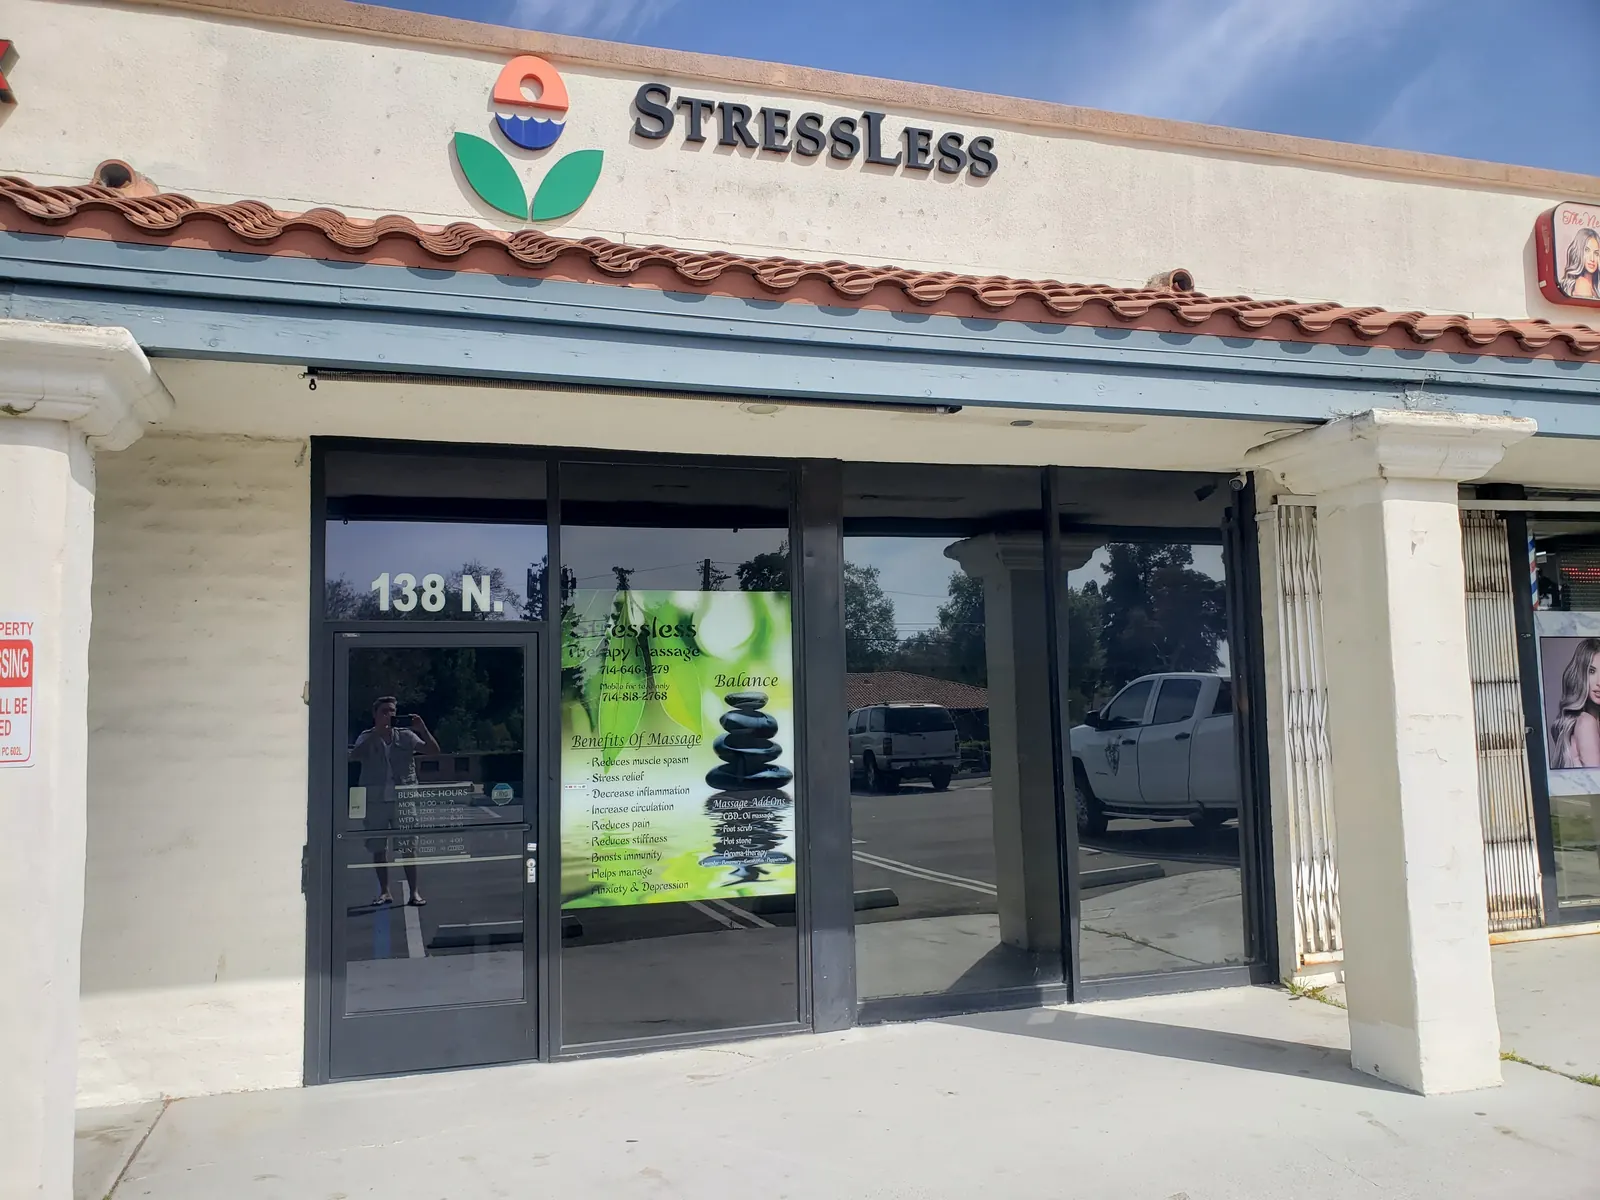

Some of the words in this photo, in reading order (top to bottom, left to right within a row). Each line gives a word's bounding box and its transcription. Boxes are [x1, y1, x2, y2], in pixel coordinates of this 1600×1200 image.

[1562, 210, 1584, 226] The
[371, 572, 446, 612] 138
[462, 574, 503, 612] N.
[0, 648, 29, 679] SING
[714, 672, 779, 688] Balance
[602, 691, 668, 702] 714-818-2768
[14, 697, 28, 714] BE
[571, 733, 625, 751] Benefits
[628, 733, 644, 750] Of
[647, 732, 702, 749] Massage
[1, 746, 10, 756] PC
[592, 757, 630, 768] Reduces
[632, 755, 661, 766] muscle
[663, 756, 689, 767] spasm
[592, 773, 620, 783] Stress
[622, 771, 645, 782] relief
[397, 790, 436, 799] BUSINESS
[438, 788, 469, 797] HOURS
[592, 788, 635, 799] Decrease
[637, 785, 690, 798] inflammation
[592, 803, 629, 815] Increase
[631, 802, 674, 813] circulation
[712, 799, 749, 811] Massage
[750, 796, 786, 807] Add-Ons
[751, 813, 775, 821] massage
[592, 820, 630, 831] Reduces
[632, 818, 650, 831] pain
[723, 825, 736, 833] Foot
[737, 824, 753, 832] scrub
[592, 836, 630, 847] Reduces
[632, 834, 668, 845] stiffness
[724, 837, 734, 845] Hot
[591, 852, 622, 863] Boosts
[624, 849, 663, 861] immunity
[591, 868, 616, 880] Helps
[618, 867, 653, 879] manage
[591, 882, 629, 896] Anxiety
[630, 881, 639, 893] &
[642, 880, 690, 894] Depression
